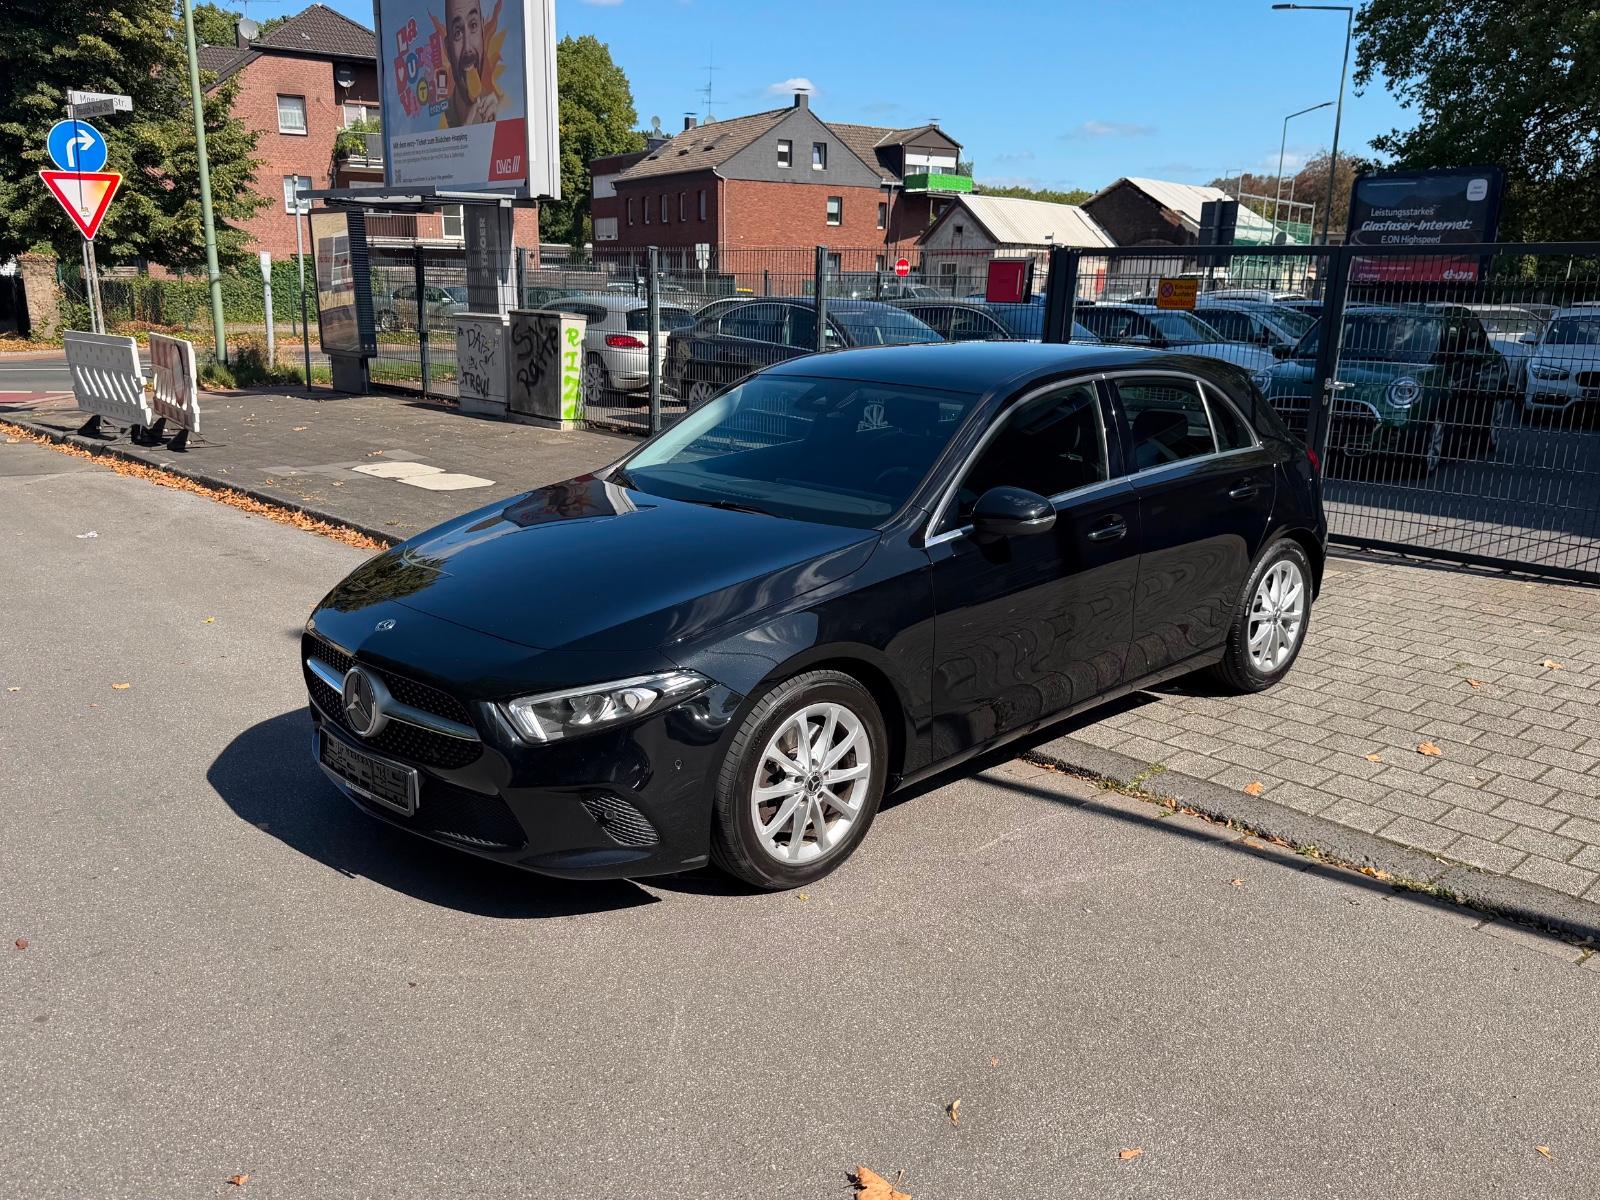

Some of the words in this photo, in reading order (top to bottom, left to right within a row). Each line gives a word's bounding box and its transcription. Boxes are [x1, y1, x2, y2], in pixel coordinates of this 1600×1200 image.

[114, 97, 127, 108] Str.
[496, 158, 512, 175] DVG
[1371, 208, 1434, 217] Leistungsstarkes
[1381, 235, 1400, 244] E.ON
[1400, 235, 1442, 245] Highspeed
